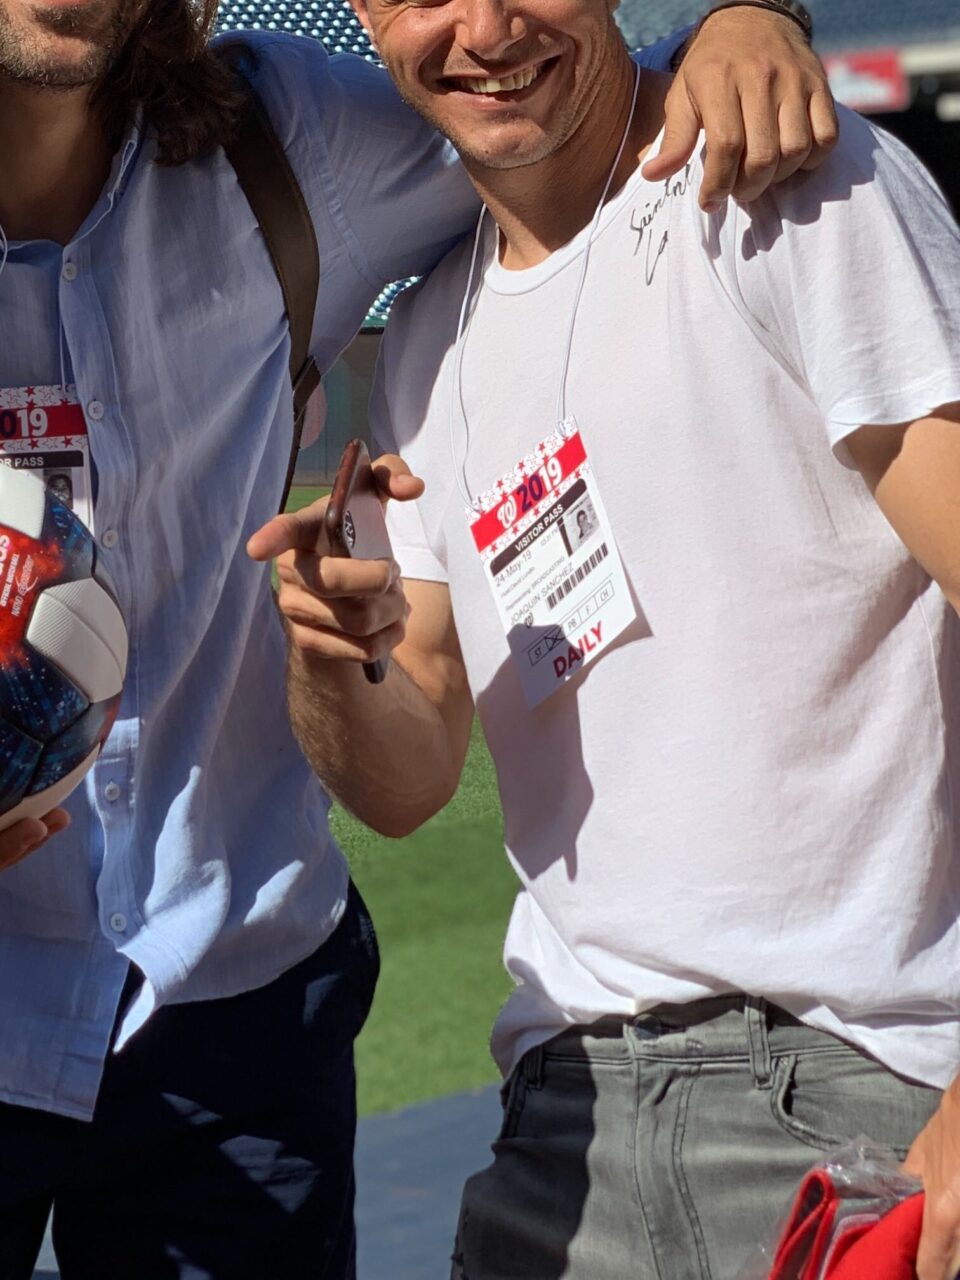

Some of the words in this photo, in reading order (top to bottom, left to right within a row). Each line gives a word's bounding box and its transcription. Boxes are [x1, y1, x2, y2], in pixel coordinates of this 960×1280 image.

[14, 457, 44, 468] PASS
[516, 457, 563, 513] 2019
[514, 522, 545, 552] VISITOR
[543, 504, 564, 526] PASS
[553, 620, 604, 678] DAILY
